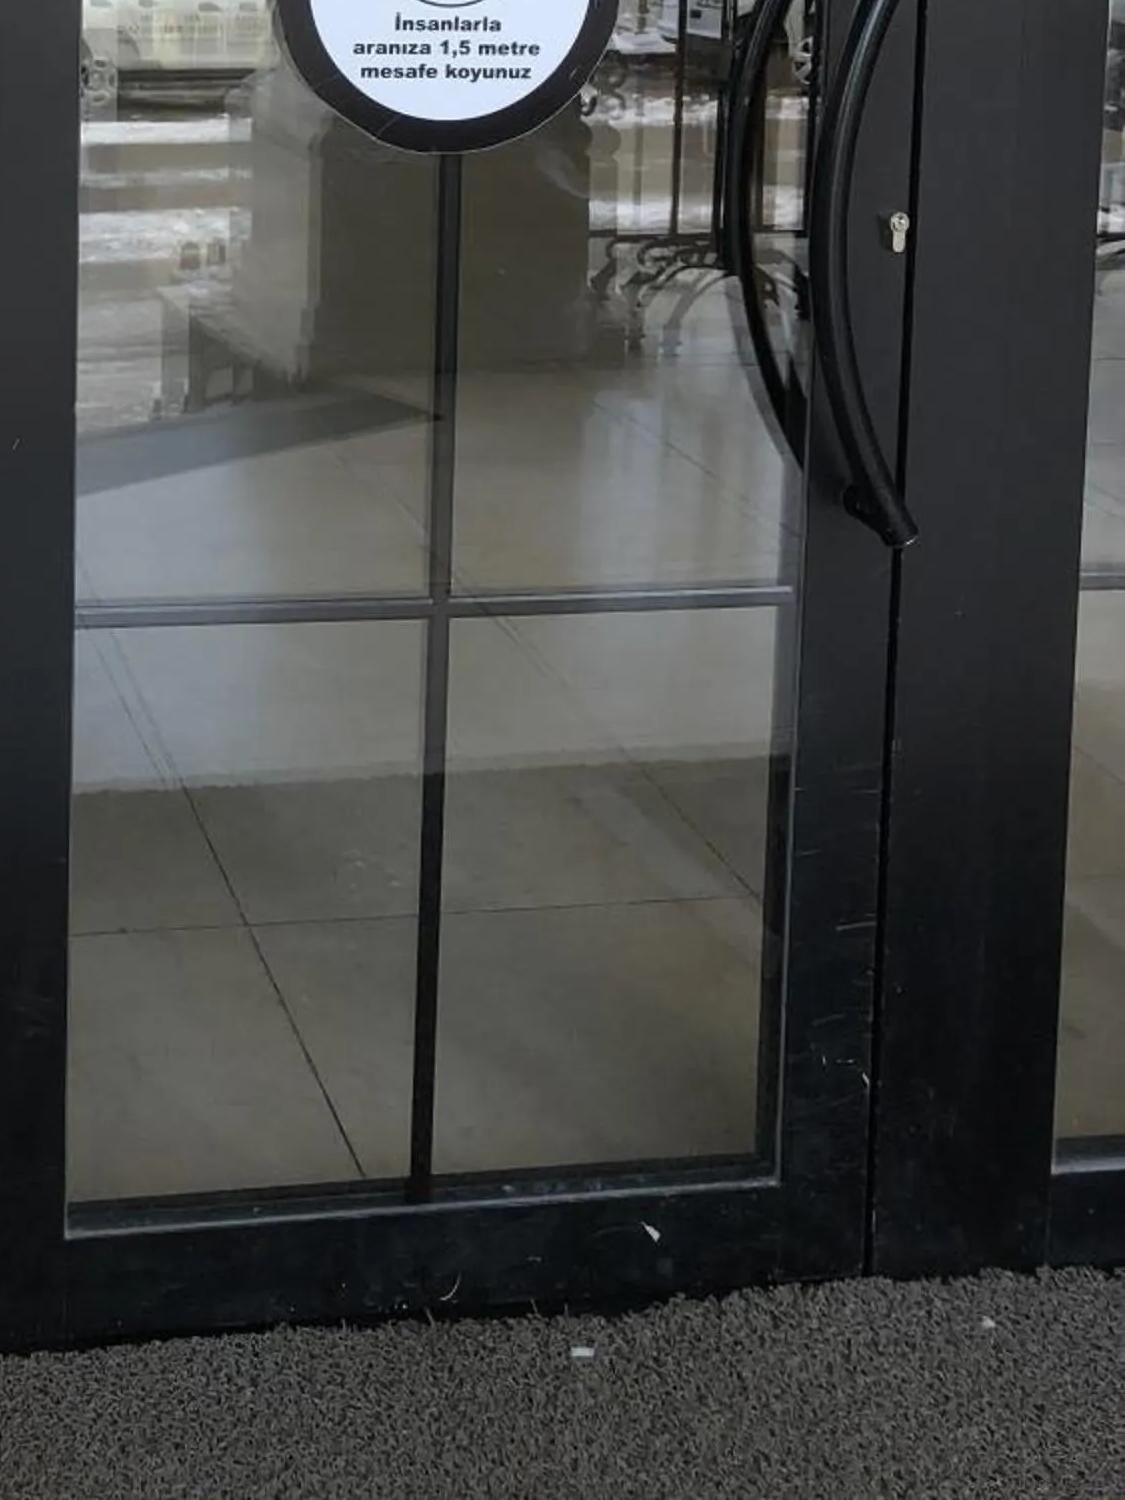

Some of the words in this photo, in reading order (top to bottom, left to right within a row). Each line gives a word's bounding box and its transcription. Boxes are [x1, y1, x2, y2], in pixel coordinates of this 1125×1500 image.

[394, 11, 502, 32] İnsanlarla
[352, 41, 432, 56] aranıza
[439, 39, 471, 59] 1,5
[477, 40, 541, 57] metre
[359, 63, 439, 80] mesafe
[444, 63, 532, 83] koyunuz
